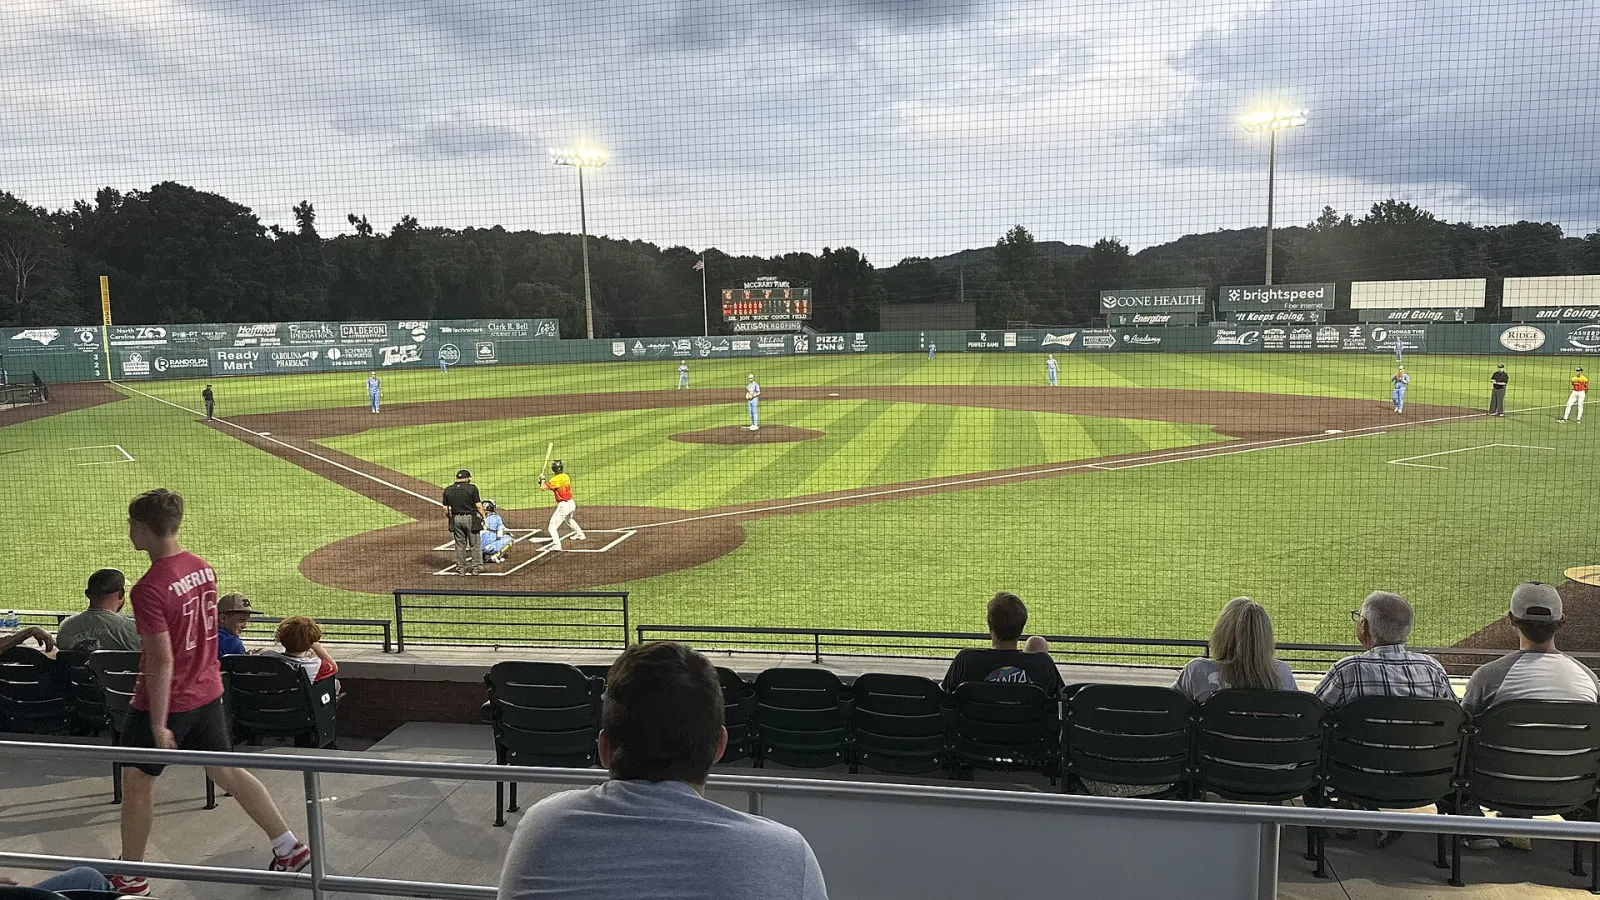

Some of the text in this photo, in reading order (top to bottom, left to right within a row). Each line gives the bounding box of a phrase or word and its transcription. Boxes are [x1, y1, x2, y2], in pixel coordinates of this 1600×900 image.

[1243, 288, 1324, 303] brightspeed
[1117, 296, 1151, 307] CONE
[1247, 312, 1275, 322] Keeps
[1276, 312, 1305, 322] Going,
[1388, 310, 1444, 320] and Going,
[1536, 308, 1562, 318] and
[1132, 314, 1171, 324] Energizer
[238, 324, 277, 335] Hoffman
[398, 321, 428, 329] PEPSI
[516, 322, 528, 330] Bell
[343, 326, 384, 335] CALDERON
[816, 335, 844, 343] PIZZA
[218, 351, 259, 361] Ready
[271, 352, 302, 360] CAROLINA
[224, 361, 254, 370] Mart
[276, 360, 309, 368] PHARMACY
[182, 590, 218, 651] 76
